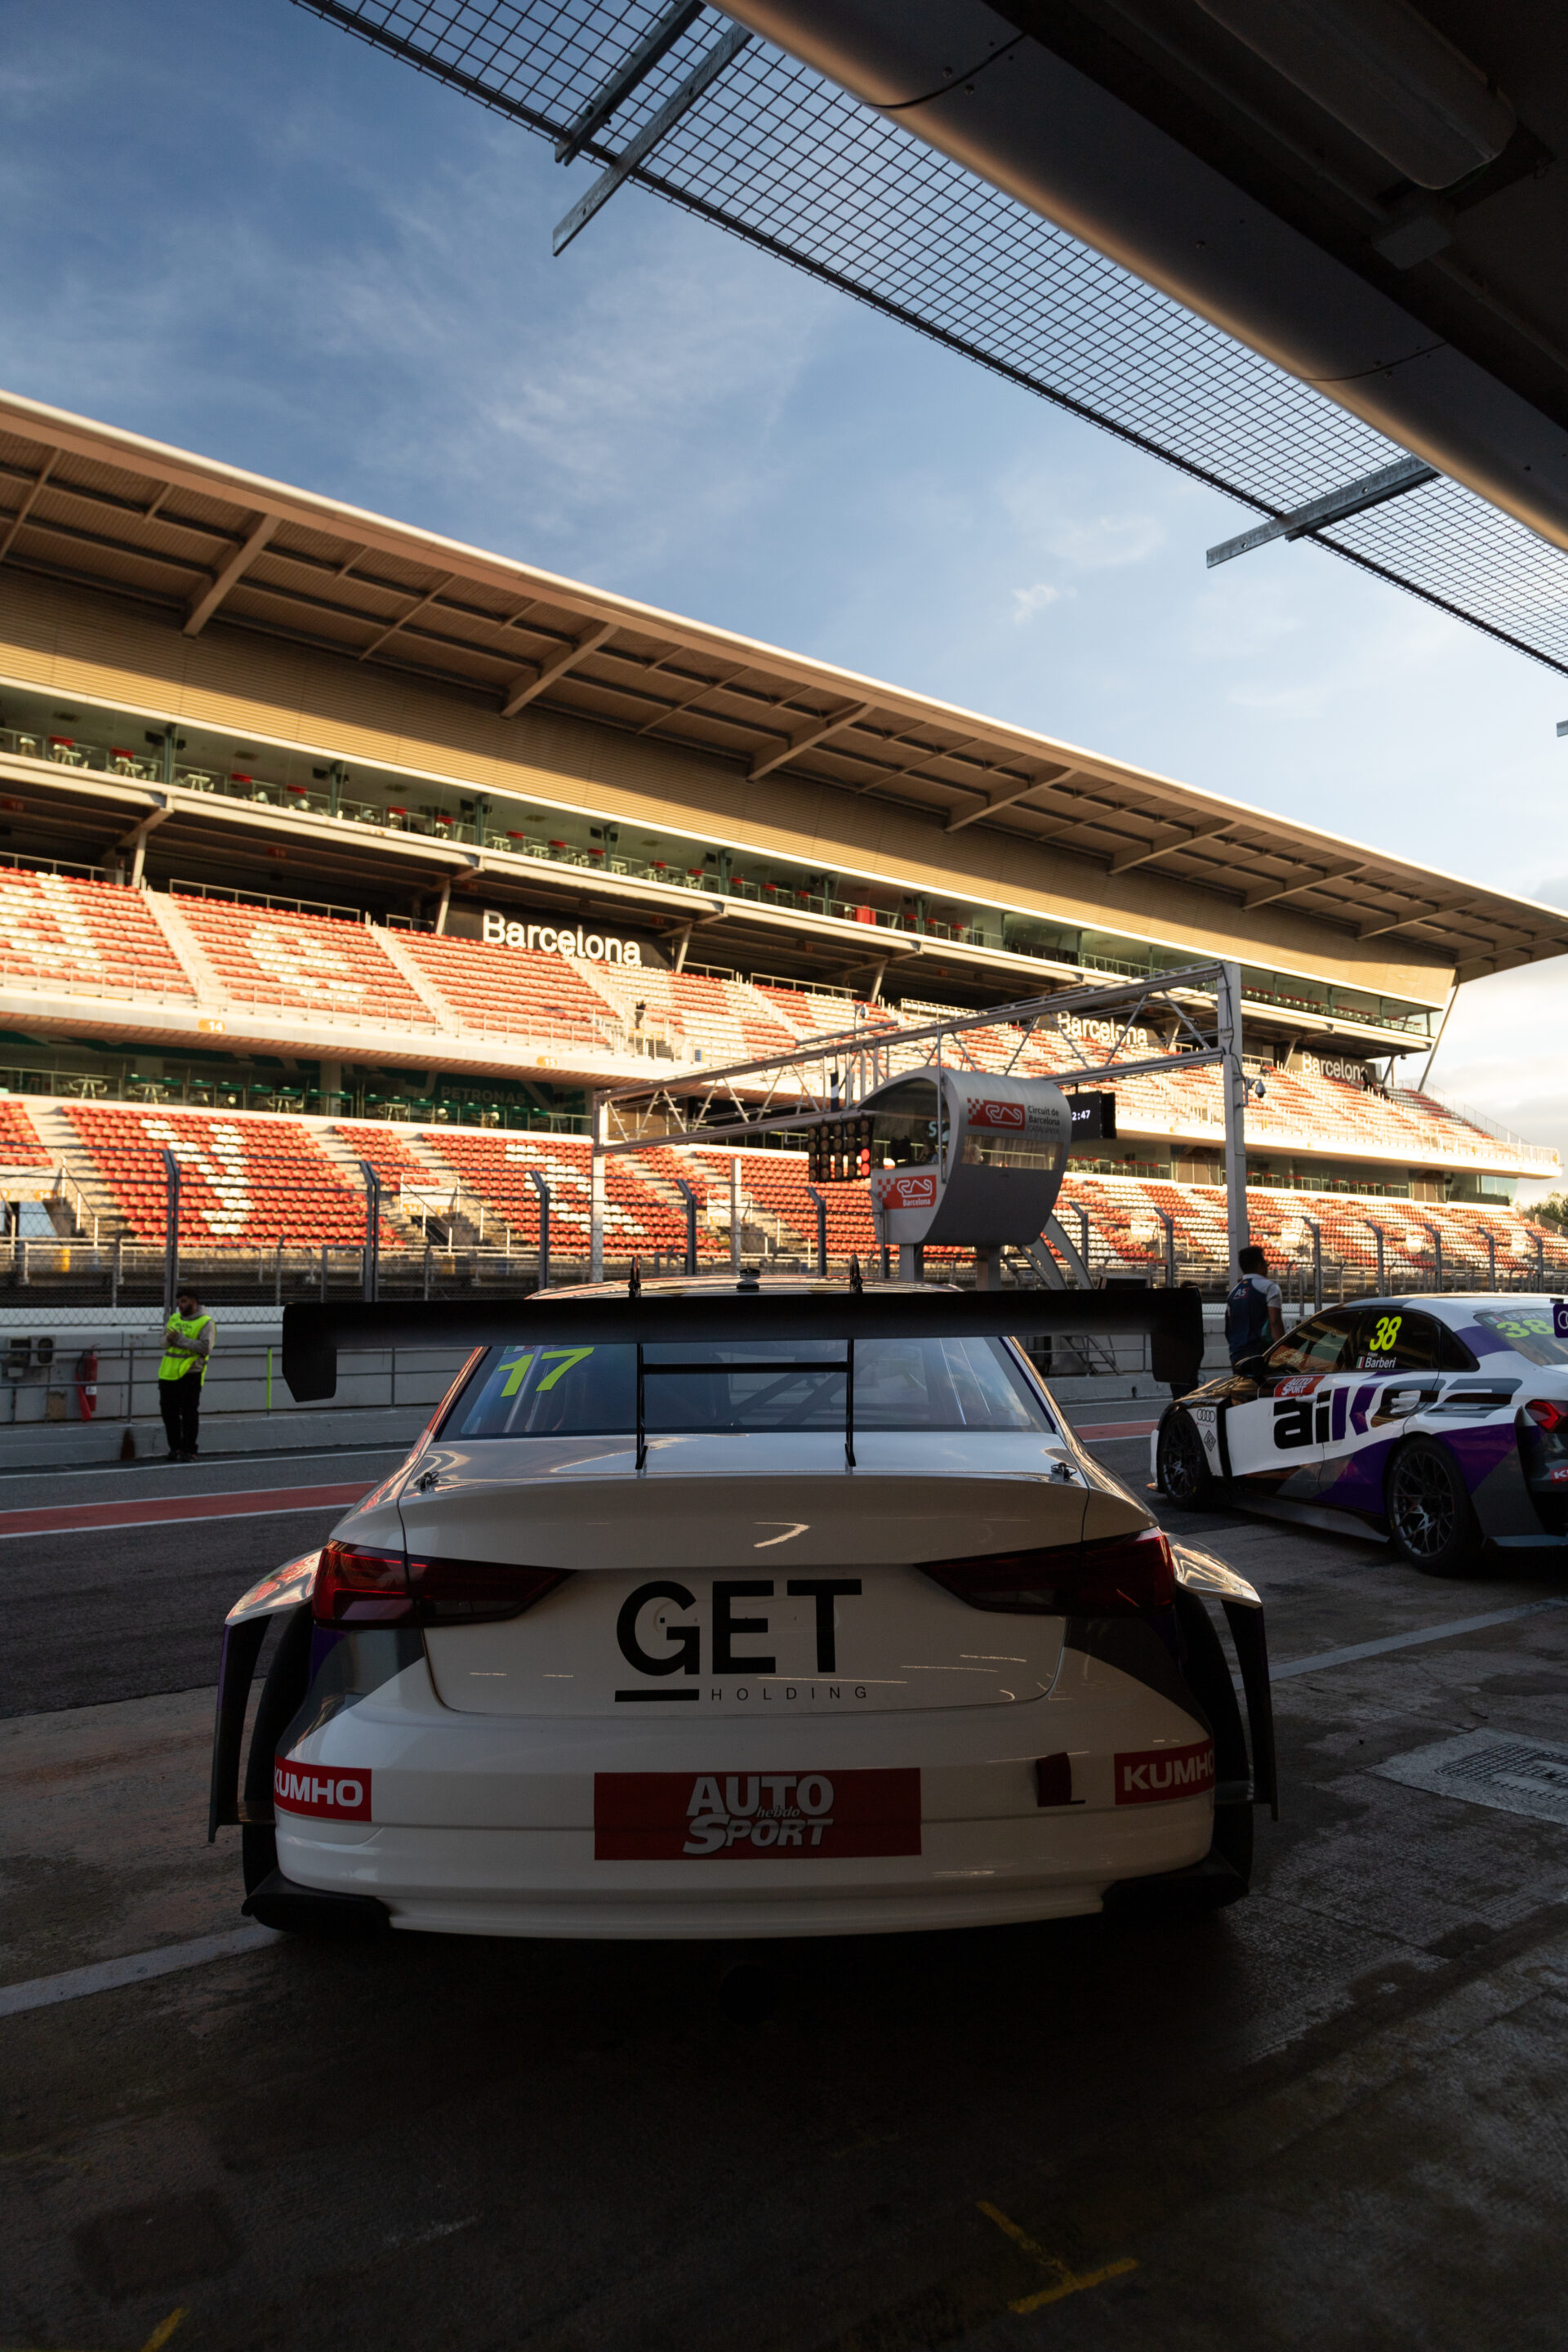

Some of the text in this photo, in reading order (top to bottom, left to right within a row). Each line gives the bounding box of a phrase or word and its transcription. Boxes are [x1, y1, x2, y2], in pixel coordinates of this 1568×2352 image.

[483, 909, 641, 966] Barcelona
[208, 1021, 223, 1032] 14
[1058, 1010, 1148, 1046] Barcelona
[545, 1058, 556, 1067] 15
[441, 1086, 526, 1105] PETRONAS
[1028, 1105, 1059, 1116] Circuit de
[1029, 1116, 1060, 1125] Barcelona
[903, 1198, 931, 1206] Barcelona
[1370, 1316, 1402, 1351] 38
[1496, 1319, 1555, 1339] 38
[1365, 1356, 1396, 1369] Barberi
[497, 1347, 595, 1397] 17
[1281, 1385, 1306, 1396] SPORT
[1288, 1378, 1314, 1386] AUTO
[617, 1579, 862, 1676] GET
[711, 1686, 867, 1701] HOLDING
[274, 1766, 363, 1807] KUMHO
[685, 1774, 835, 1817] AUTO
[756, 1805, 800, 1819] hebdo
[682, 1813, 835, 1855] SPORT
